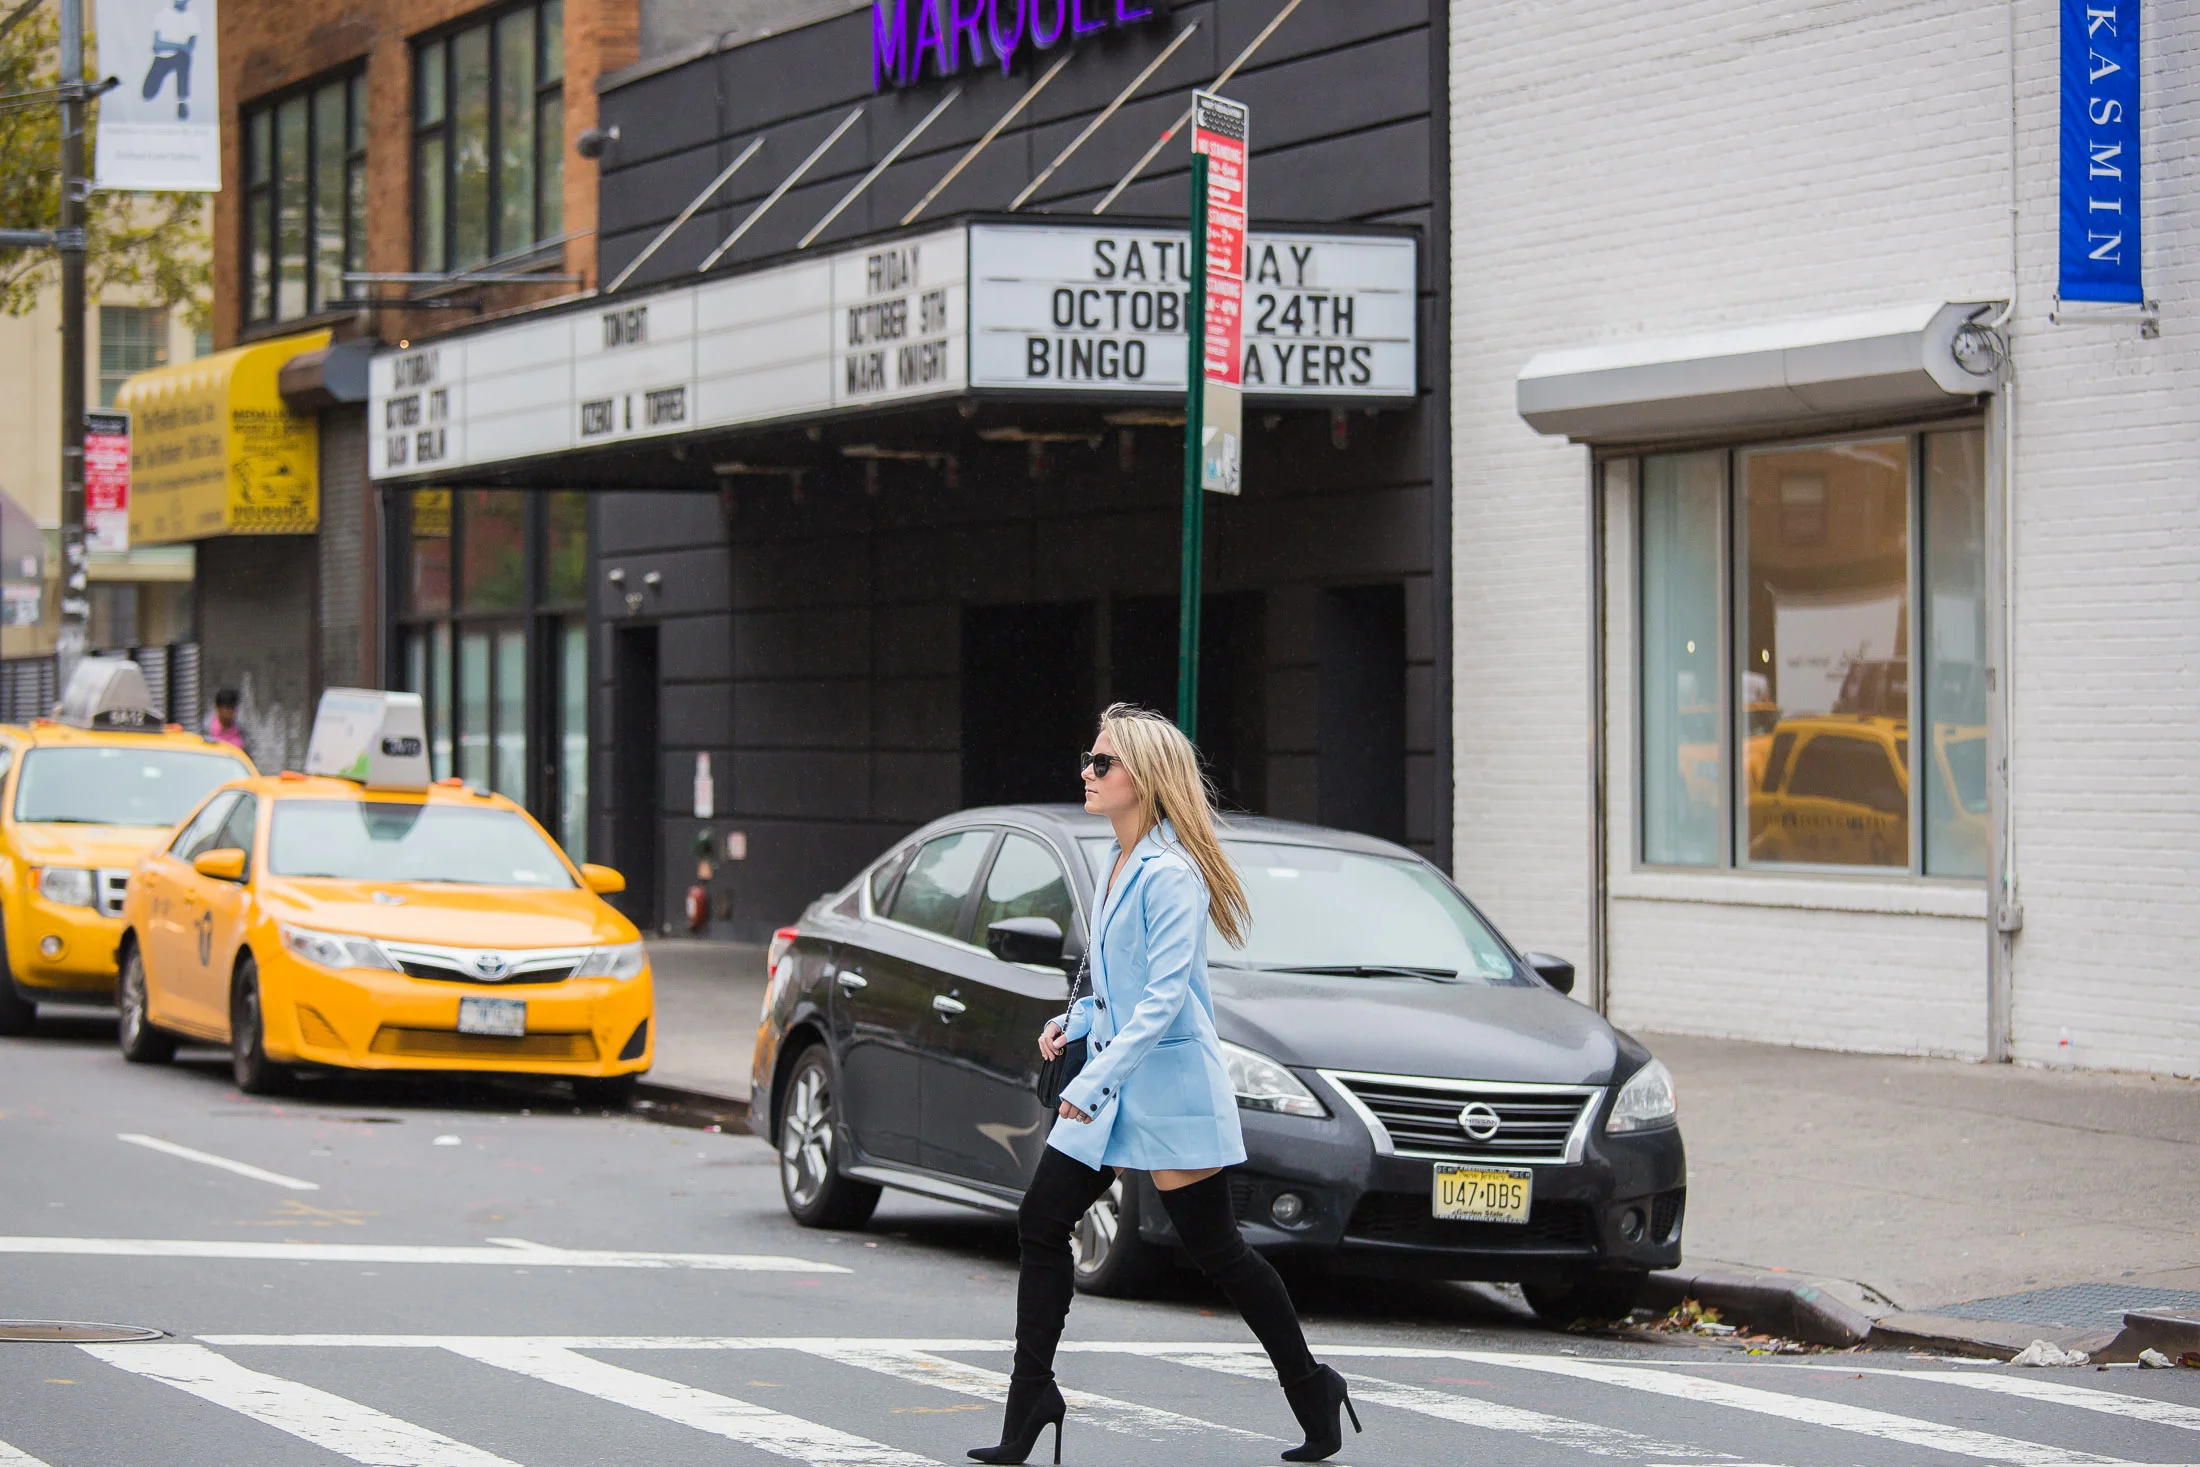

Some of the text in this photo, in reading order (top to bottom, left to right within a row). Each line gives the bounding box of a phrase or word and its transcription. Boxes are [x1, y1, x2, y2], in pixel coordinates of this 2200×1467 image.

[1209, 141, 1242, 165] STANDING
[2086, 3, 2123, 267] KASMIN
[1207, 207, 1242, 231] STANDING
[868, 246, 919, 295] FRIDAY
[1093, 240, 1313, 286] SATUAY
[1206, 277, 1240, 299] STANDING
[848, 289, 946, 346] OCTOBER 9TH
[1052, 288, 1190, 331] OCTOB
[1257, 293, 1354, 337] 24TH
[847, 340, 947, 396] MARK KNIGHT
[1026, 337, 1372, 386] BINGO AYERS
[1464, 1118, 1497, 1126] NISSAN
[1456, 1208, 1482, 1216] Garden
